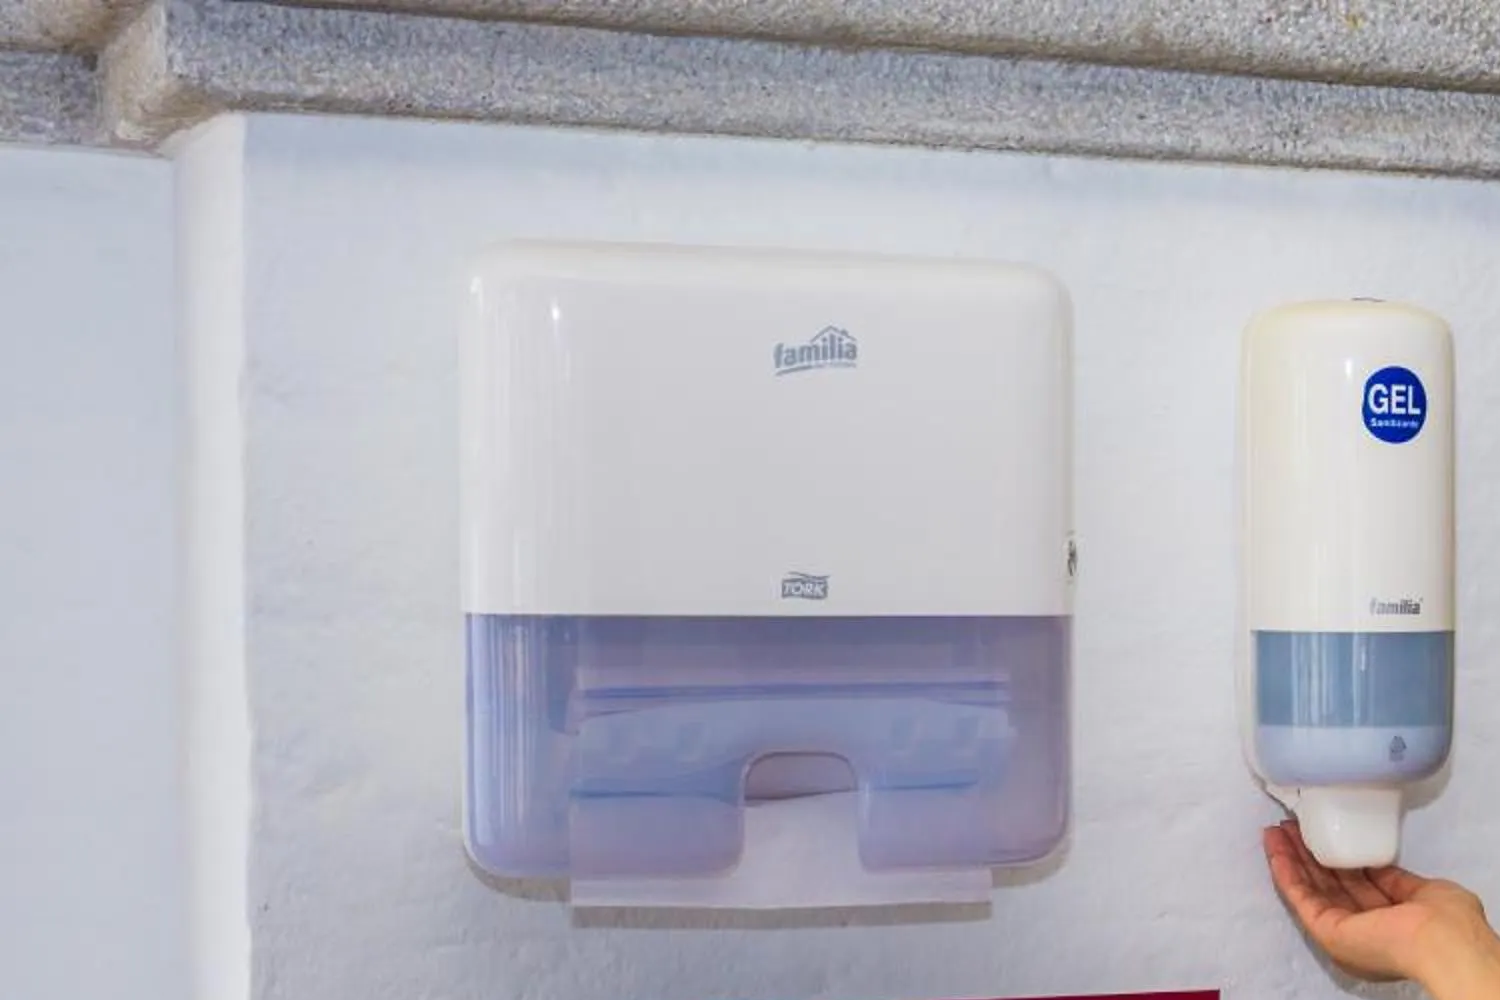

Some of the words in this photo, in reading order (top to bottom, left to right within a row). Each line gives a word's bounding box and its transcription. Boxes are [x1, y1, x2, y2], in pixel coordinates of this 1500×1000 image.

[773, 333, 857, 369] familia
[1368, 383, 1421, 414] GEL
[783, 581, 825, 597] TORK
